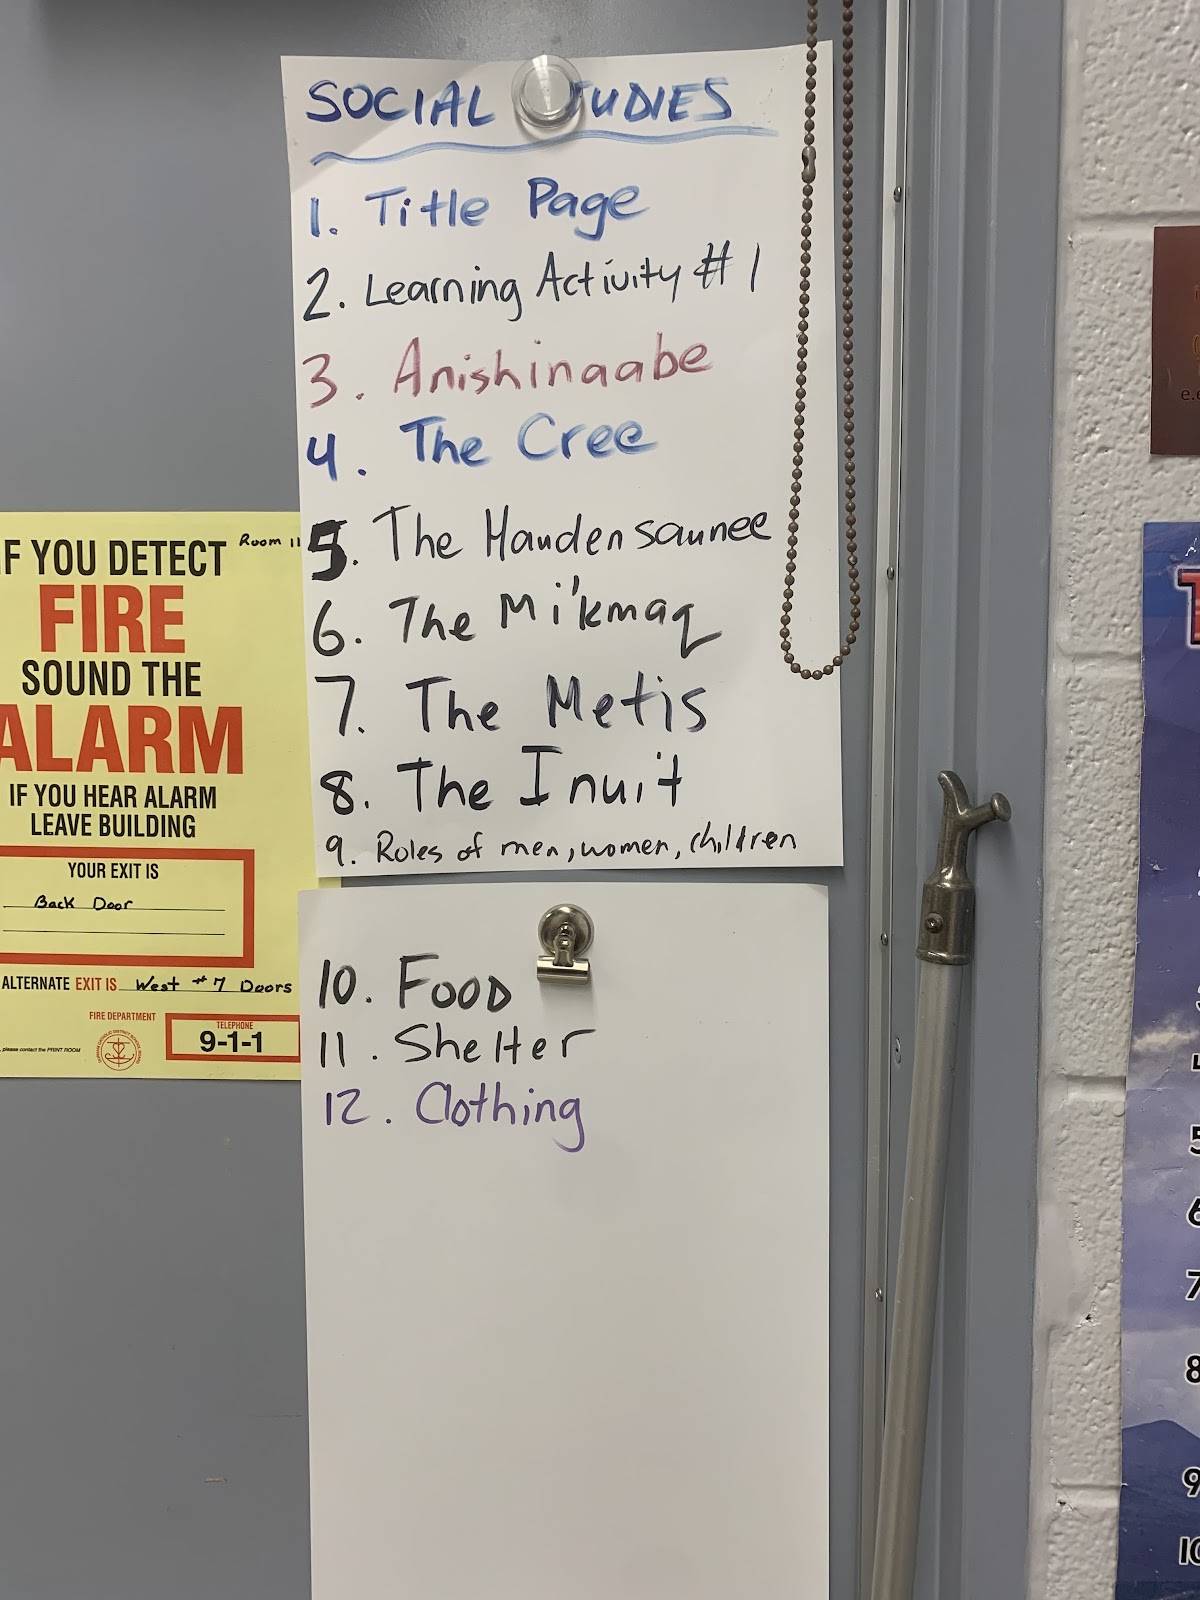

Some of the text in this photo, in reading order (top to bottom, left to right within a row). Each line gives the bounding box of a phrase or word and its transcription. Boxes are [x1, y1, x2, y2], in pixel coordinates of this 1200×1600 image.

[306, 76, 734, 127] SOCIAL TUDIES
[311, 177, 651, 241] 1. Title Page
[303, 240, 760, 322] 2. Learning Activity # 1
[303, 332, 711, 408] 3. Anishinaabe
[307, 412, 659, 480] 4. The Cree
[0, 539, 226, 576] F YOU DETECT
[239, 533, 281, 546] Room
[308, 520, 358, 581] 5.
[372, 505, 463, 561] The
[40, 584, 185, 653] FIRE
[313, 600, 361, 656] 6.
[389, 596, 475, 643] The
[22, 660, 201, 696] SOUND THE
[315, 671, 706, 736] 7. The Metis
[0, 704, 243, 774] ALARM
[10, 784, 216, 808] IF YOU HEAR ALARM
[320, 746, 682, 815] 8. The Inuit
[32, 813, 195, 838] LEAVE BUILDING
[326, 835, 355, 866] 9.
[377, 830, 442, 863] Roles
[457, 832, 483, 861] of
[691, 821, 796, 854] children
[68, 862, 158, 879] YOUR EXIT IS
[34, 894, 134, 911] Back Door
[2, 976, 116, 991] ALTERNATE EXIT IS
[136, 975, 181, 992] West
[240, 979, 293, 994] Doors
[319, 960, 371, 1008] 10.
[89, 1011, 157, 1022] FIRE DEPARTMENT
[215, 1021, 254, 1030] TELEPHONE
[199, 1030, 264, 1053] 9-1-1
[321, 1022, 596, 1068] 11. Shelter
[326, 1081, 585, 1152] 12. Clothing
